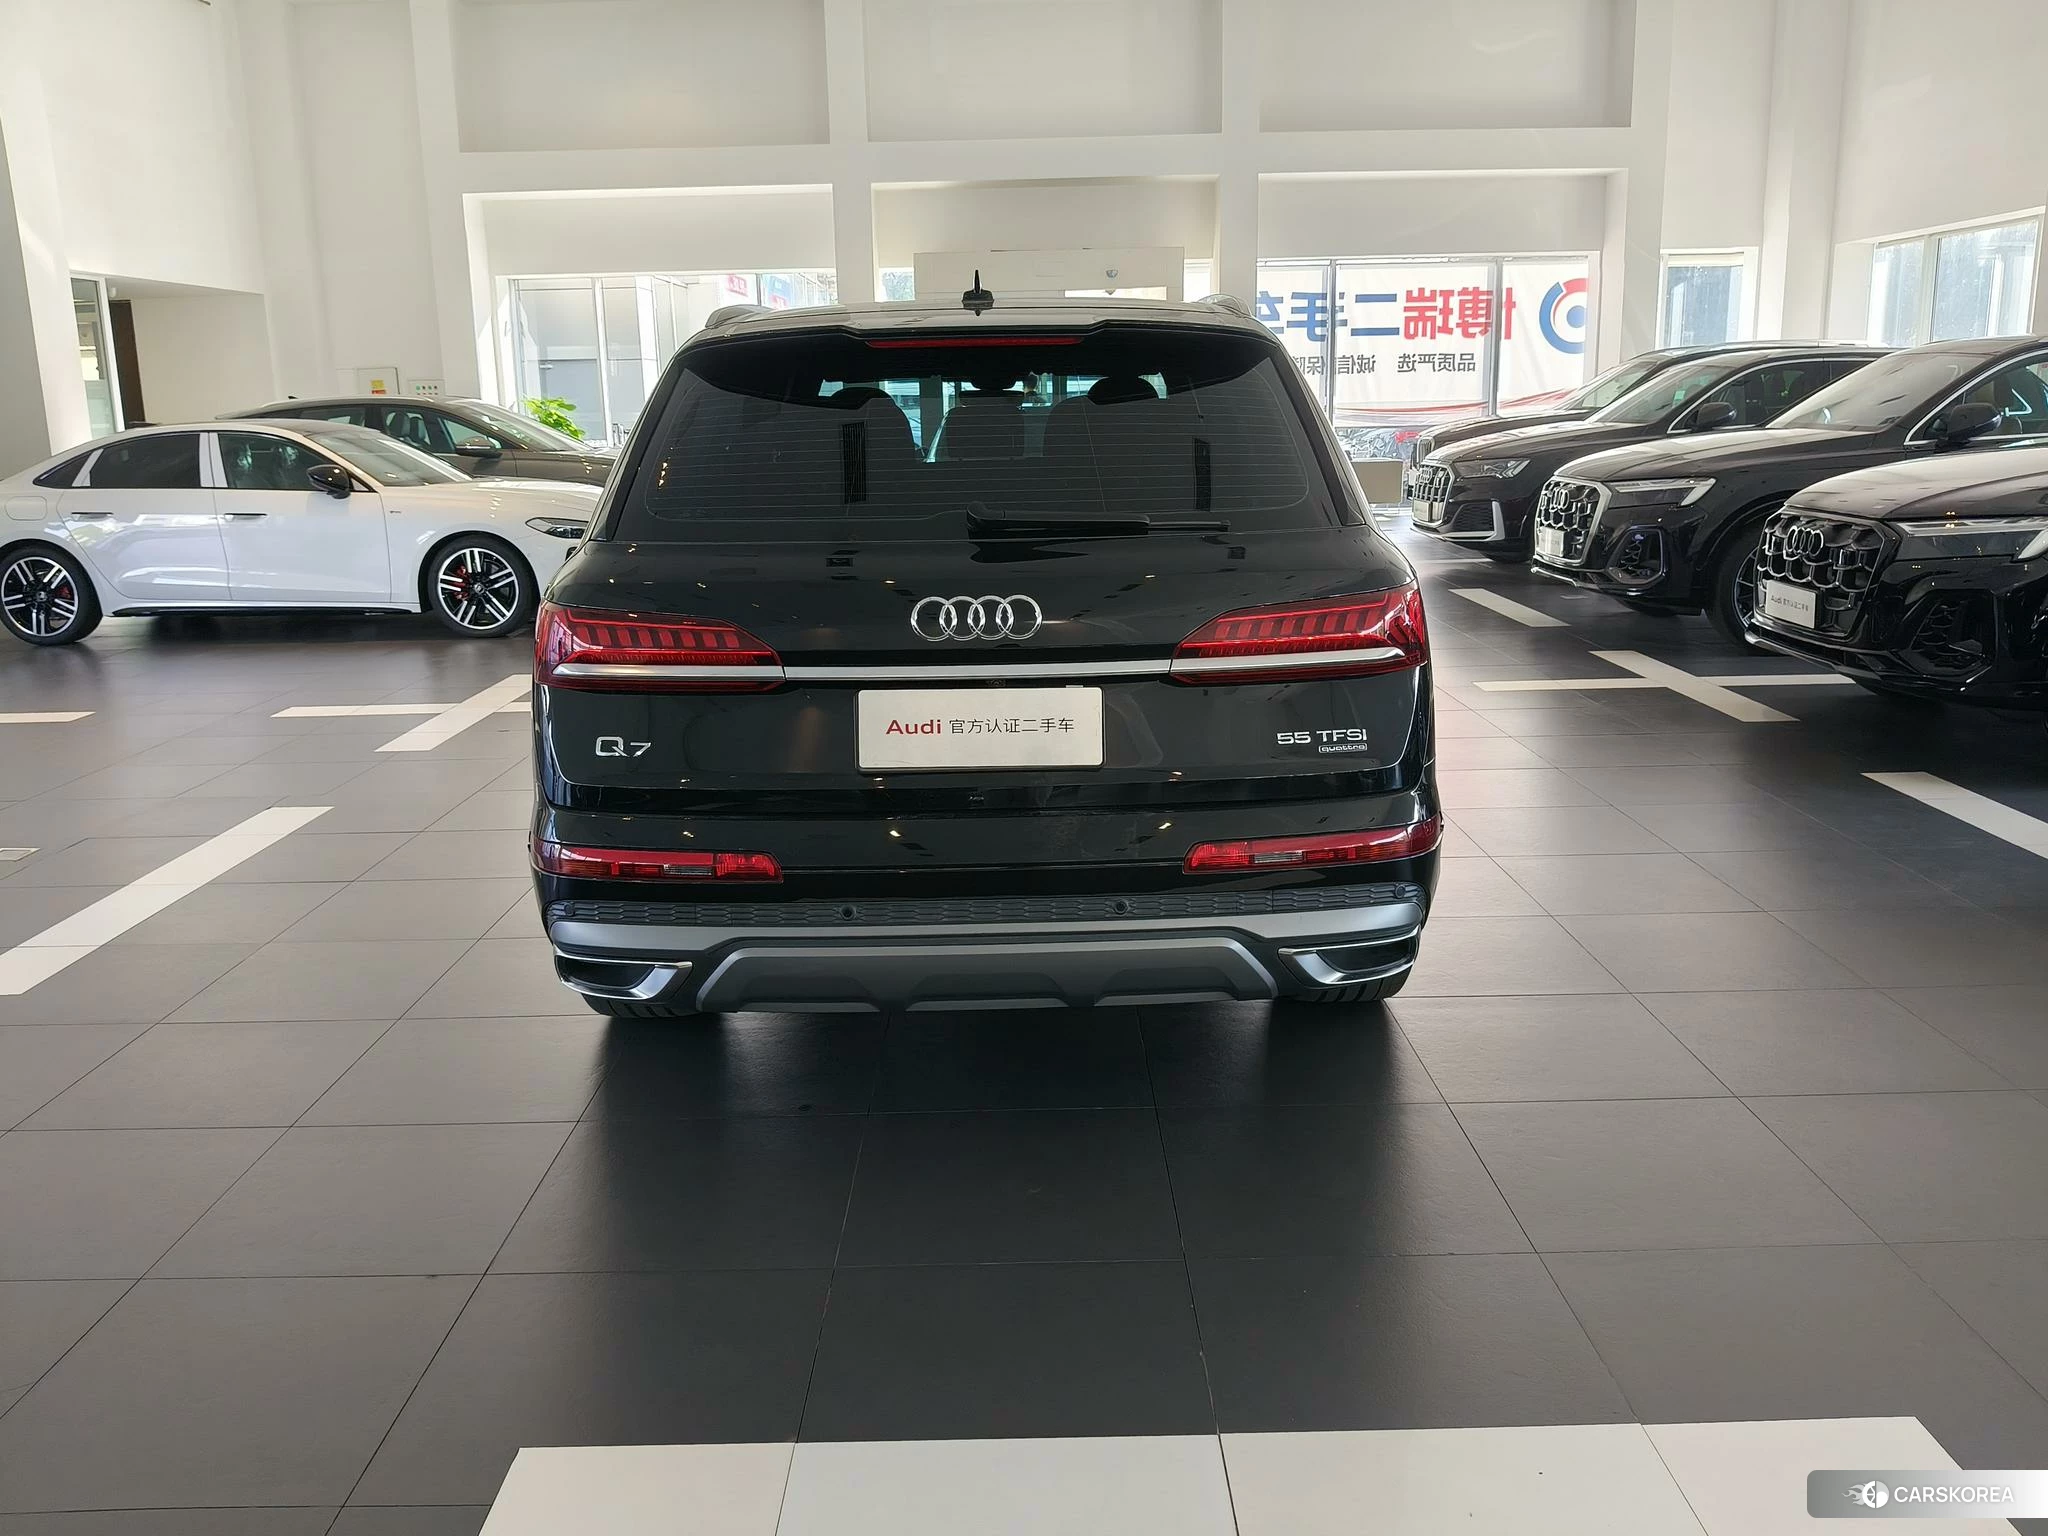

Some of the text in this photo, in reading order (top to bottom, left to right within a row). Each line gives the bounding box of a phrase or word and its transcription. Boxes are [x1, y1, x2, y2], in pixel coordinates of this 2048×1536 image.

[886, 717, 1075, 735] Audi 官方认证二手车
[1276, 728, 1368, 745] 55 TFSI
[596, 736, 652, 758] Q7
[1320, 743, 1367, 753] quattro
